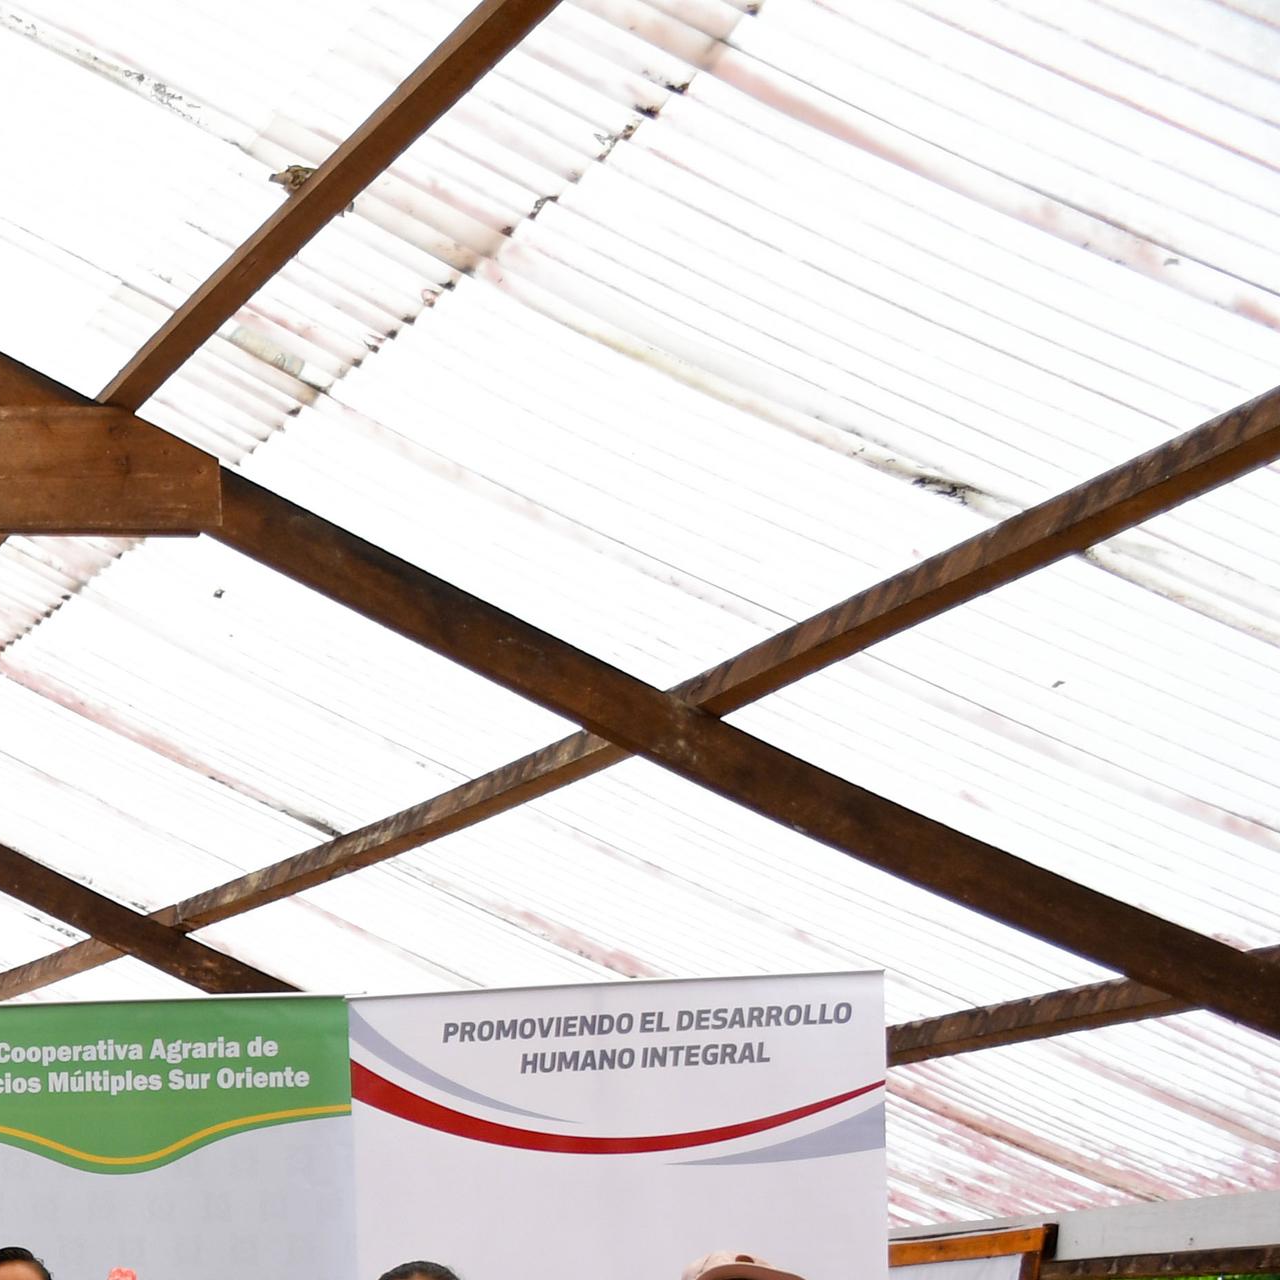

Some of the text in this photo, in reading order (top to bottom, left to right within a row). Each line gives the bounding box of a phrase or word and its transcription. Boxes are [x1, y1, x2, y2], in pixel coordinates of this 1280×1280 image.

[442, 1002, 852, 1044] PROMOVIENDO EL DESARROLLO
[150, 1036, 240, 1064] Agraria
[247, 1036, 278, 1057] de
[520, 1041, 771, 1074] HUMANO INTEGRAL
[48, 1068, 162, 1096] Múltiples
[168, 1068, 210, 1090] Sur
[216, 1066, 310, 1090] Oriente
